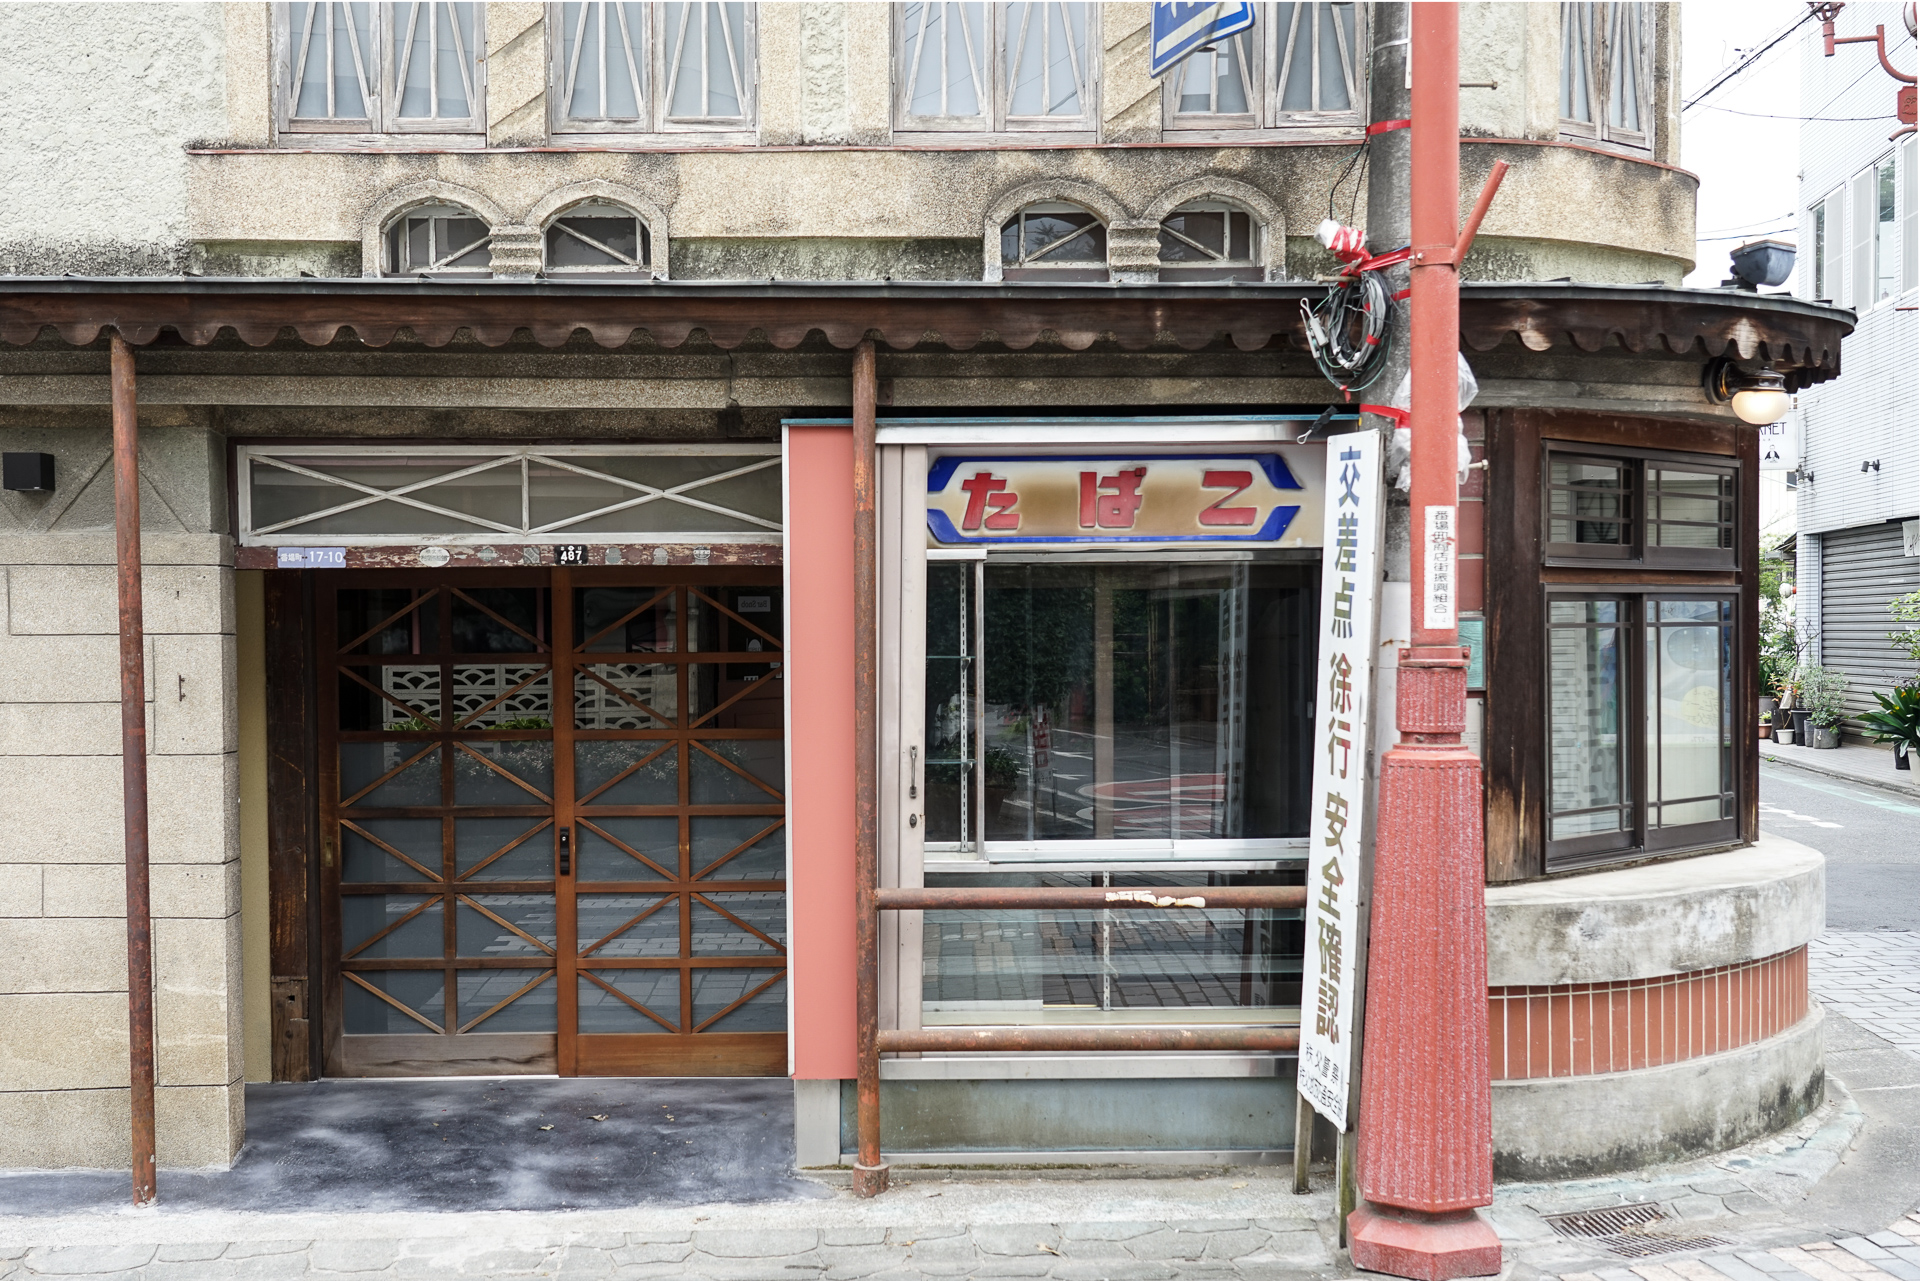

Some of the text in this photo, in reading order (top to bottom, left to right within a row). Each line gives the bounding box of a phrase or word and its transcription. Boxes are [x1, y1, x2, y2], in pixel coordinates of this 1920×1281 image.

[961, 466, 1258, 530] たばこ
[309, 550, 343, 563] 17-10
[560, 550, 582, 562] 487
[1316, 445, 1362, 1046] 交差点 徐行 安全確認
